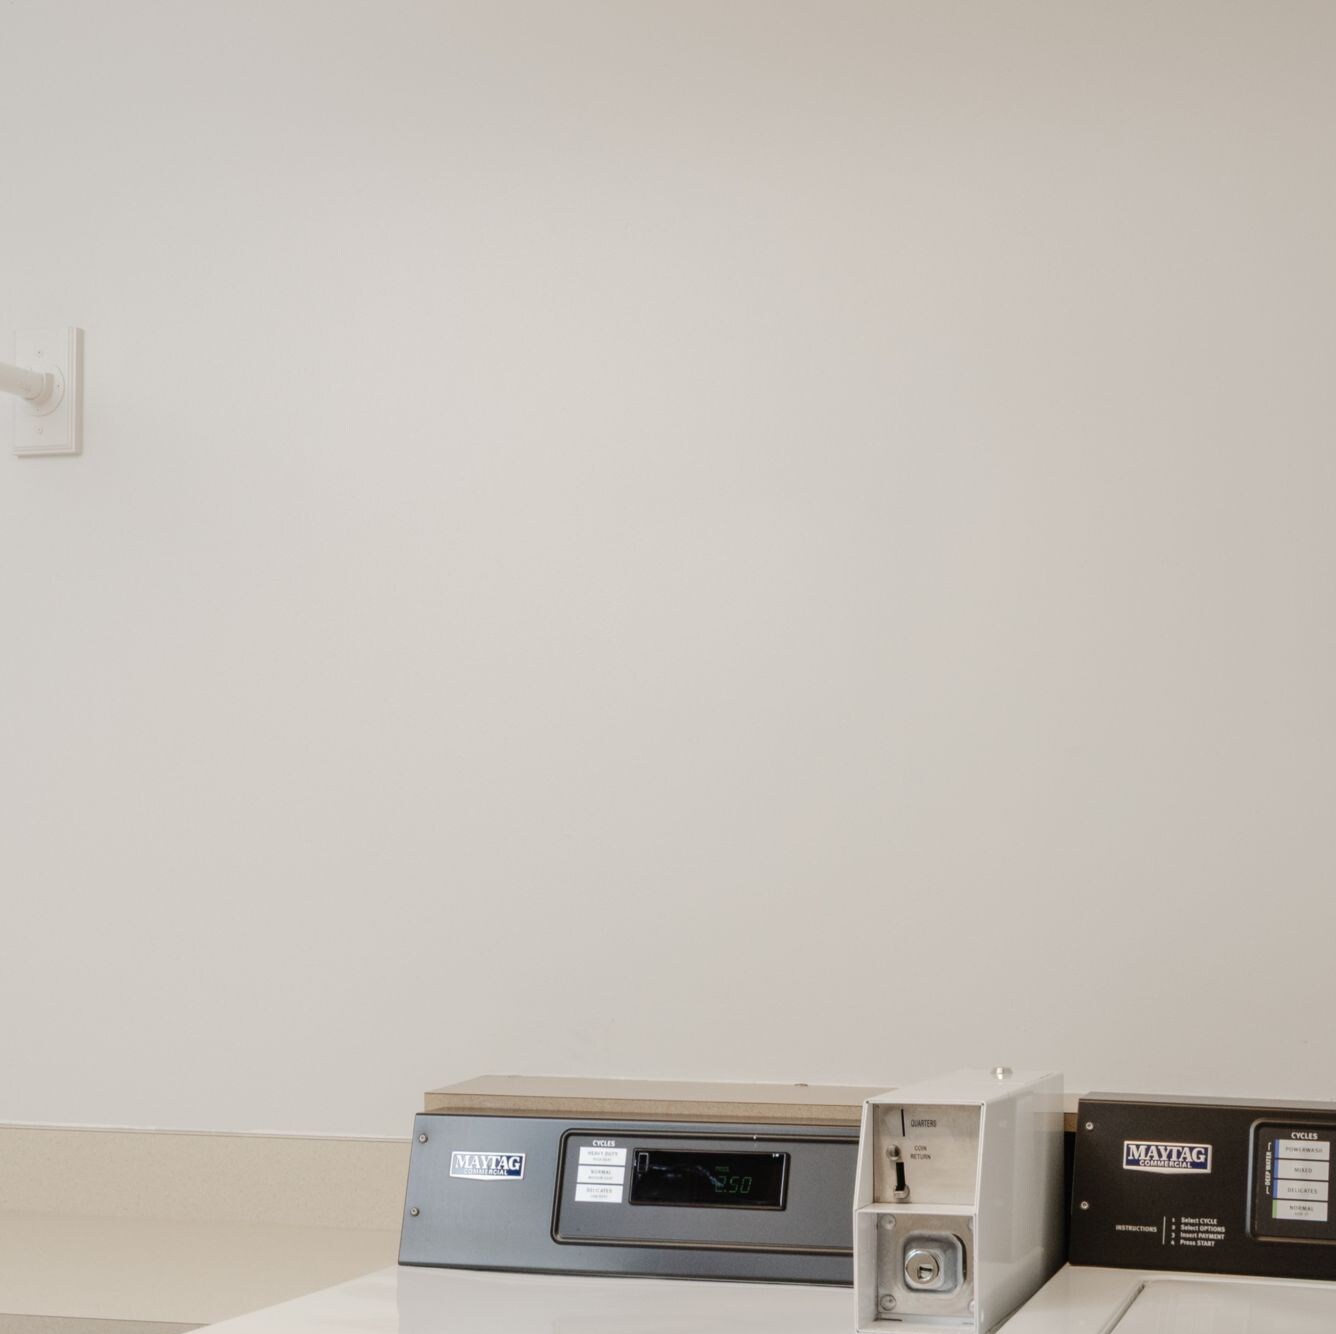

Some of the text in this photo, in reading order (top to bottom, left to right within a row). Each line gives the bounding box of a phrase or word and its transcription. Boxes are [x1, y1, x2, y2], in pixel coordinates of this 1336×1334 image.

[910, 1119, 937, 1128] QUARTERS
[1291, 1132, 1319, 1140] CYCLES
[1128, 1145, 1206, 1162] MAYTAG
[455, 1154, 521, 1170] MAYTAG
[1140, 1160, 1192, 1168] COMMERCIAL
[464, 1168, 508, 1176] COMMERCIAL
[1115, 1224, 1158, 1232] INSTRUCTIONS
